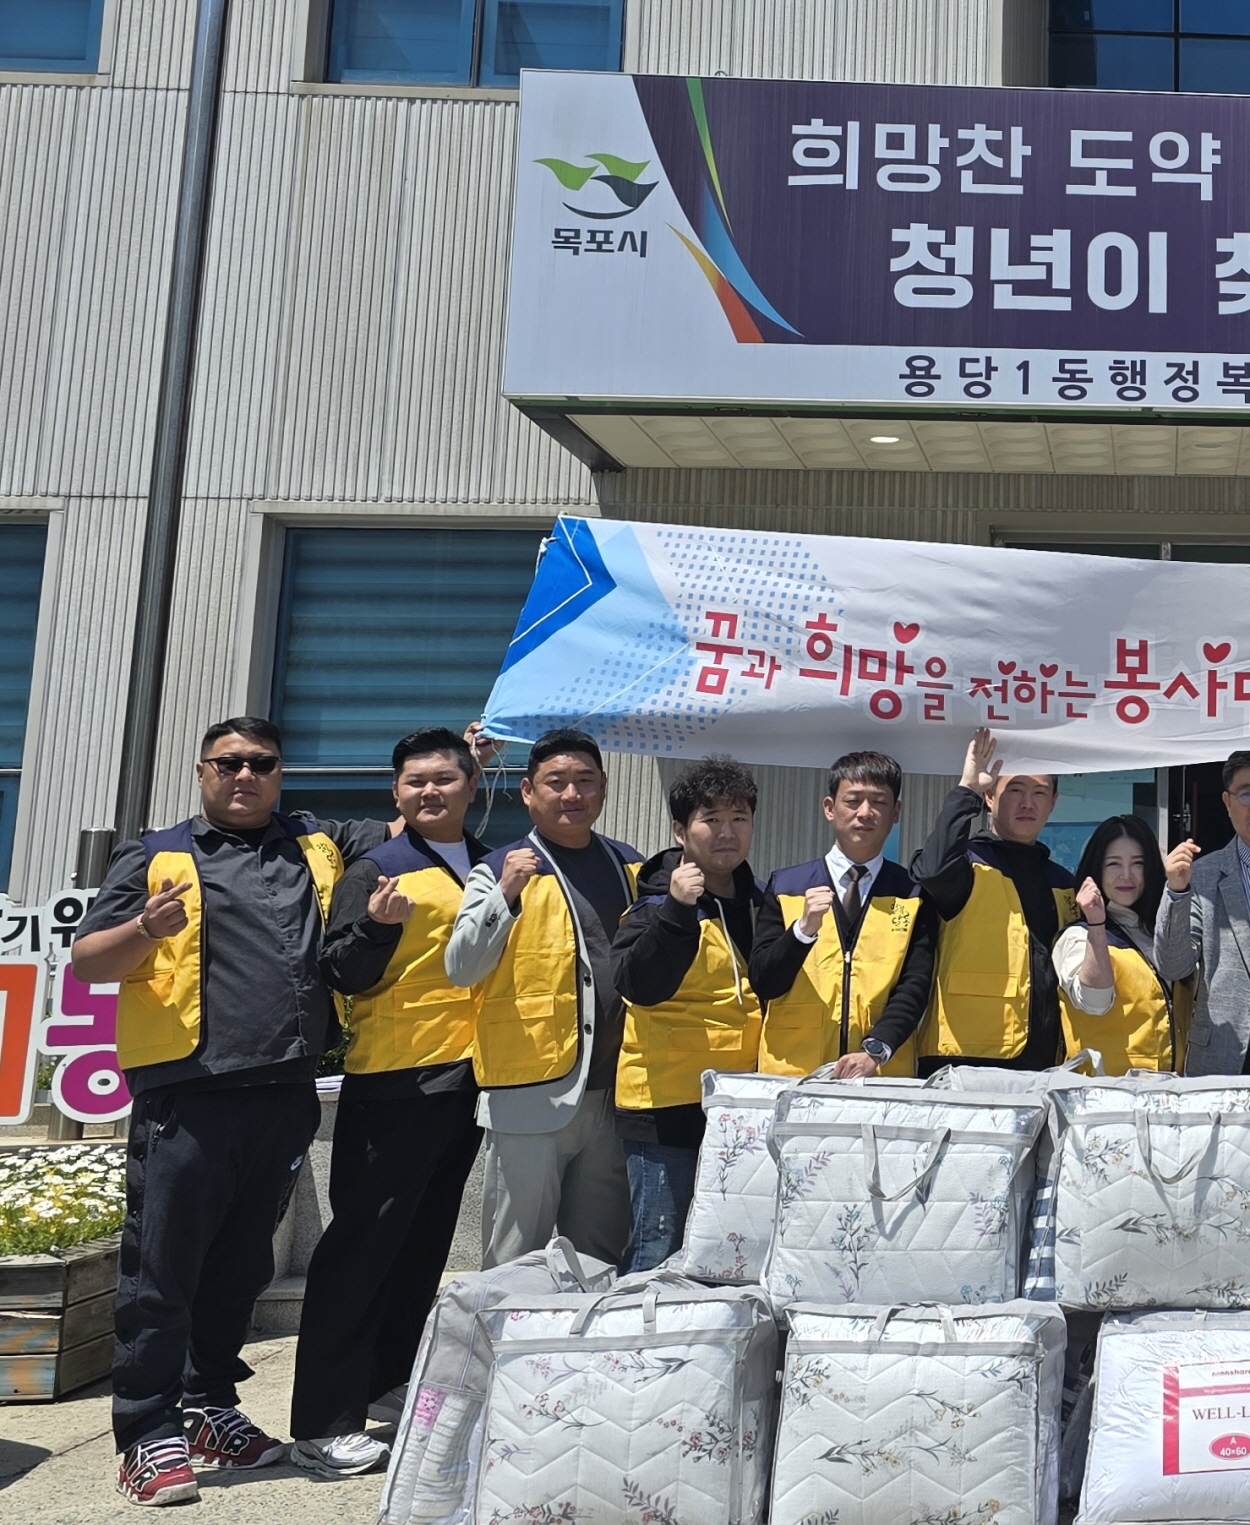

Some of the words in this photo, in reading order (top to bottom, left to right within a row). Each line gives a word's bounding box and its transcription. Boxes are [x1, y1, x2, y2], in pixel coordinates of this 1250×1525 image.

[788, 118, 1032, 196] 희망찬
[1065, 129, 1222, 201] 도약
[551, 227, 648, 259] 목포시
[889, 222, 1168, 314] 청년이
[696, 609, 782, 696] 꿈과
[798, 610, 954, 722] 희망을
[968, 660, 1097, 722] 전하는
